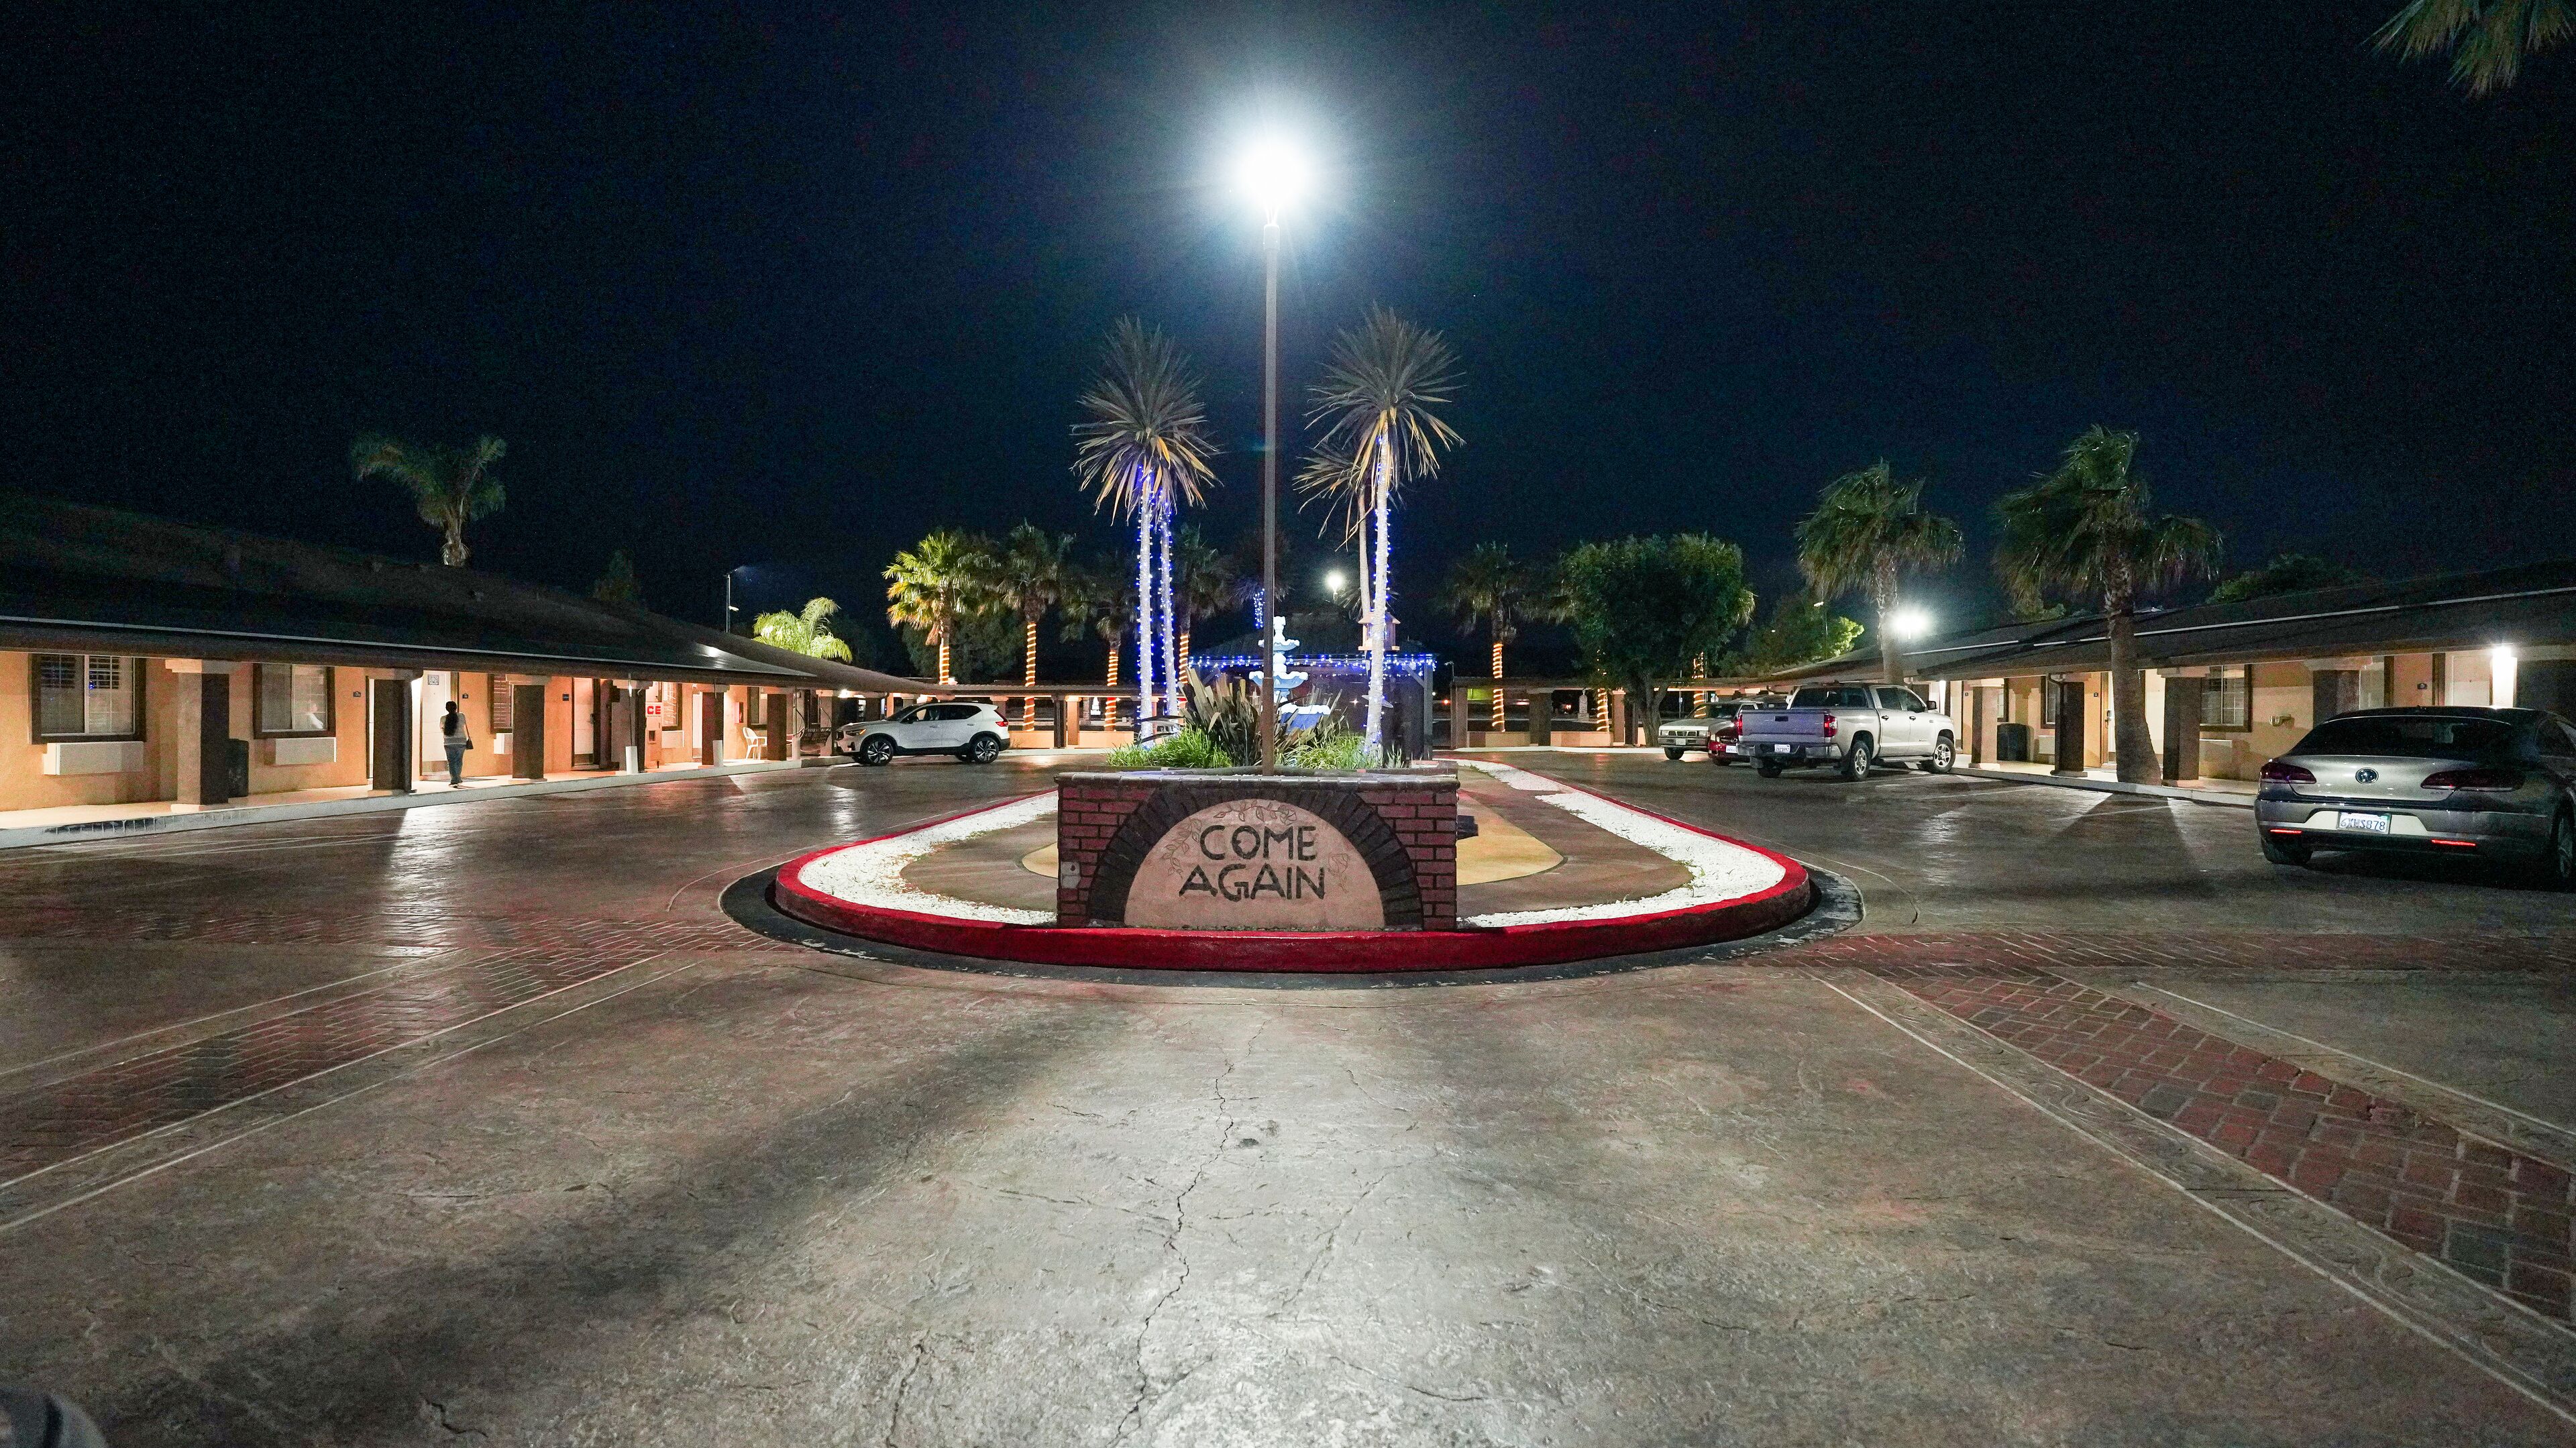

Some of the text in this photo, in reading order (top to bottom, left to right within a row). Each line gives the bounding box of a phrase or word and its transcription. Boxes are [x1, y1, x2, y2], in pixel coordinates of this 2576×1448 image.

[647, 706, 661, 714] CE
[1199, 824, 1317, 860] COME
[1179, 862, 1326, 902] AGAIN
